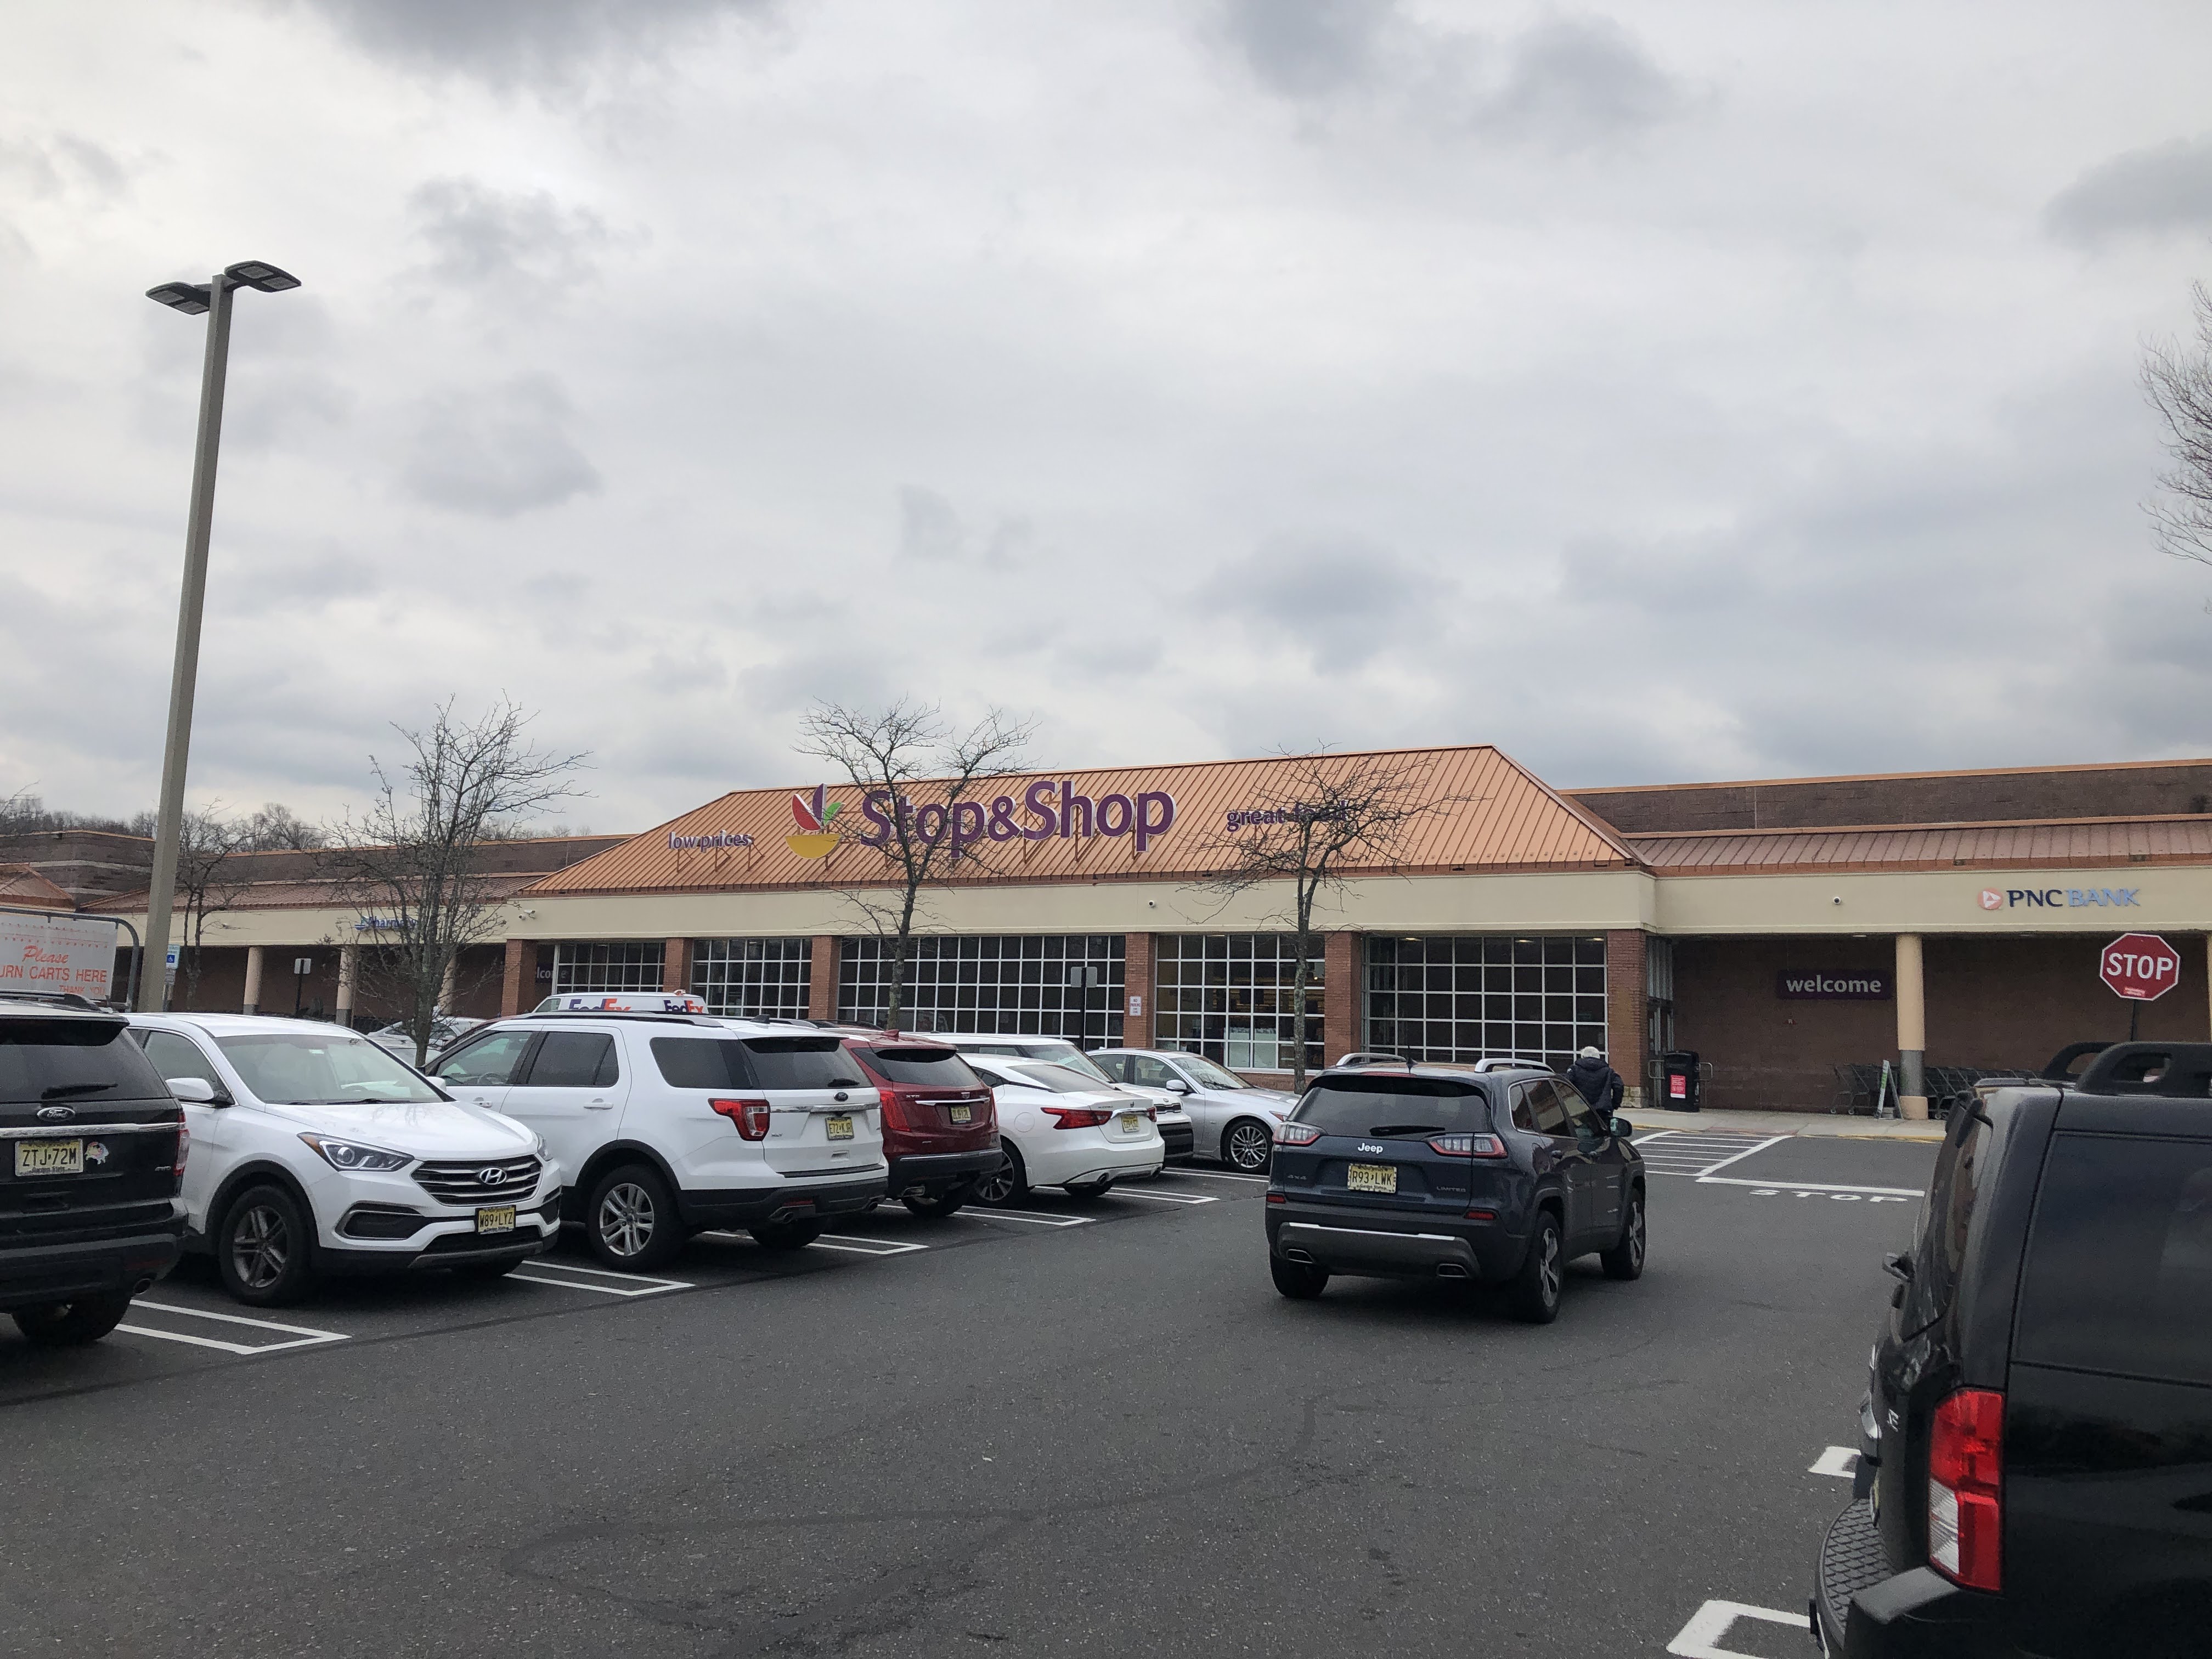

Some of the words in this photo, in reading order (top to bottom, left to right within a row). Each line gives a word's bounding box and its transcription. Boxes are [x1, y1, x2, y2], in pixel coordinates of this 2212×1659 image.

[860, 780, 1177, 860] Stop&Shop
[1227, 806, 1286, 832] great
[668, 831, 699, 850] low
[701, 830, 753, 853] prices
[22, 945, 69, 964] Please
[30, 966, 70, 981] CARTS
[76, 968, 108, 983] HERE
[2107, 952, 2173, 980] STOP
[1786, 974, 1882, 993] welcome
[46, 1109, 69, 1119] Ford
[1358, 1142, 1384, 1154] Jeep
[1749, 1189, 1908, 1203] STOP
